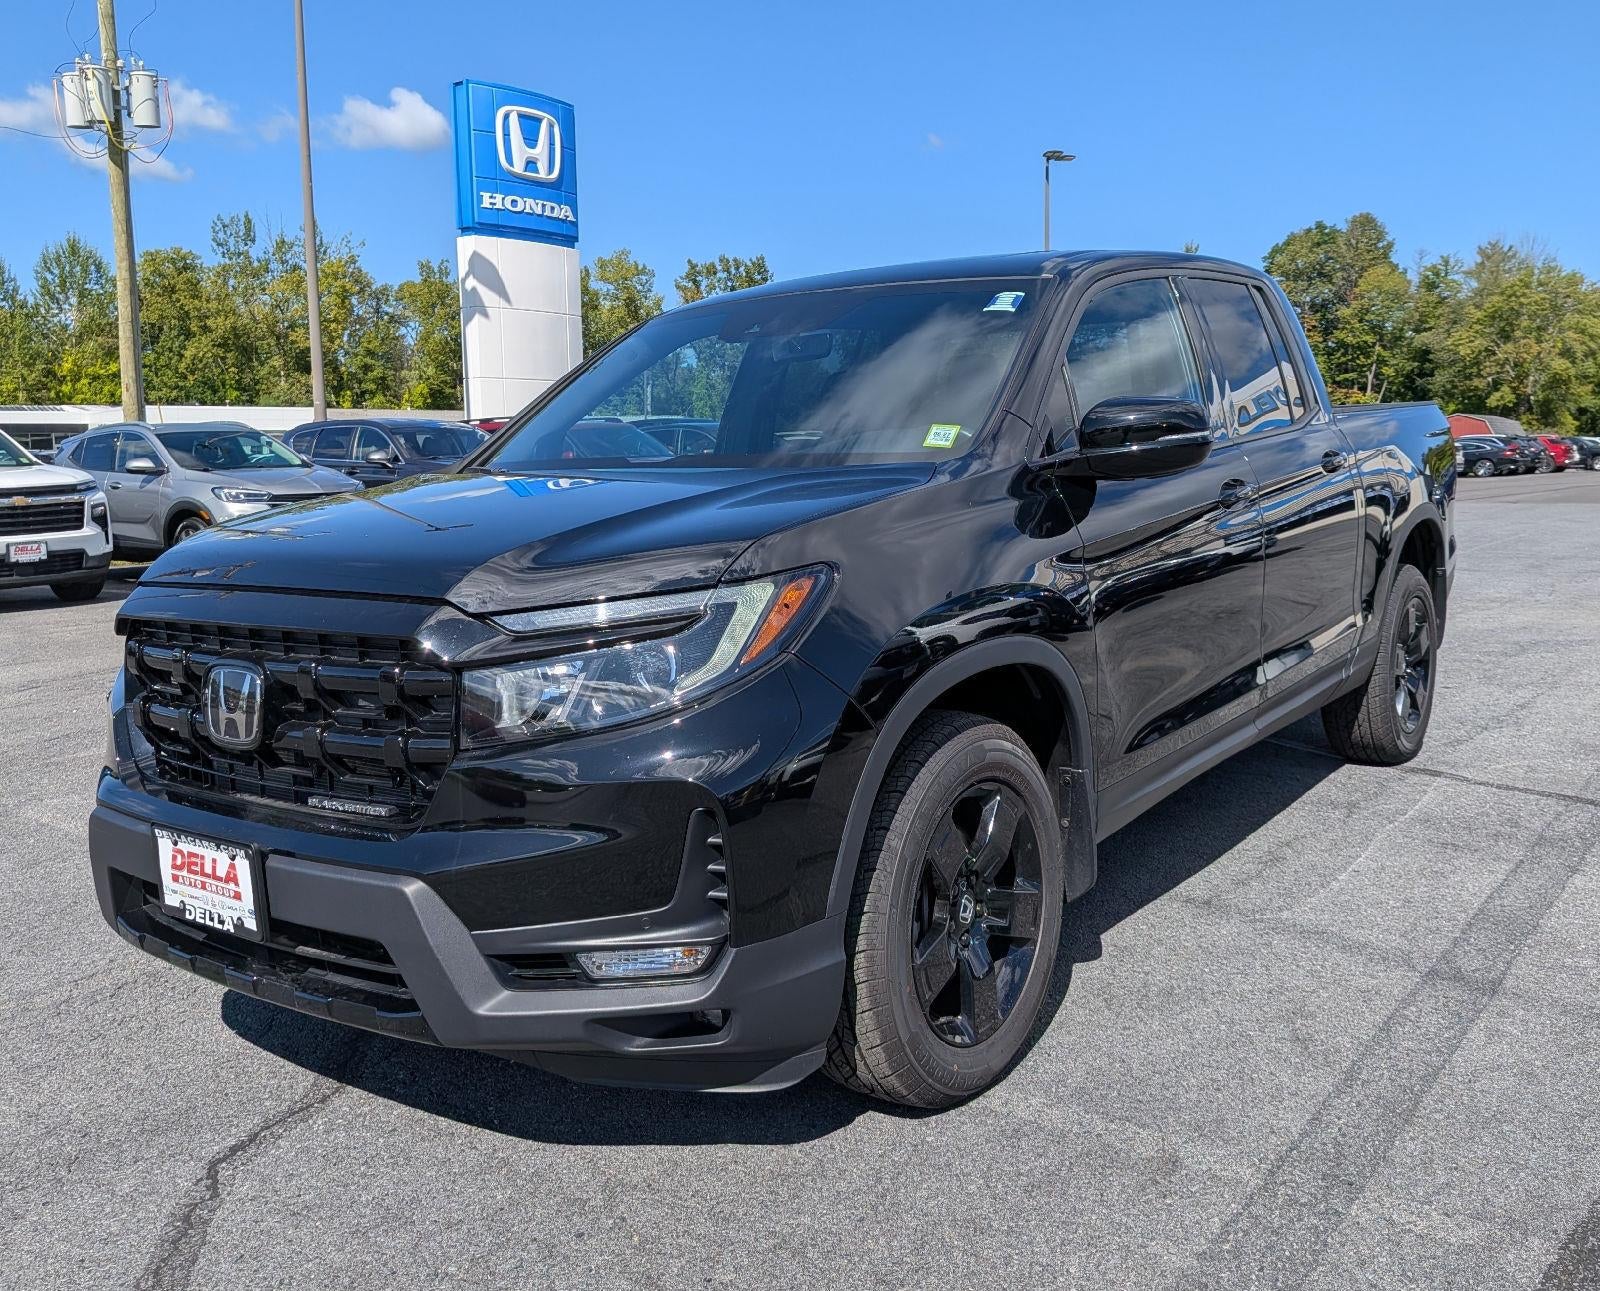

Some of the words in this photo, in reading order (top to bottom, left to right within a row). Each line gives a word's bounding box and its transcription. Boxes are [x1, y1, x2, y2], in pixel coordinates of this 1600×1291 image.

[480, 192, 577, 222] HONDA
[15, 543, 42, 553] DELLA
[154, 828, 247, 860] DELLACARS.COM
[170, 846, 240, 887] DELLA
[178, 875, 202, 889] AUTO
[205, 882, 236, 898] GROUP
[185, 904, 235, 934] DELLA
